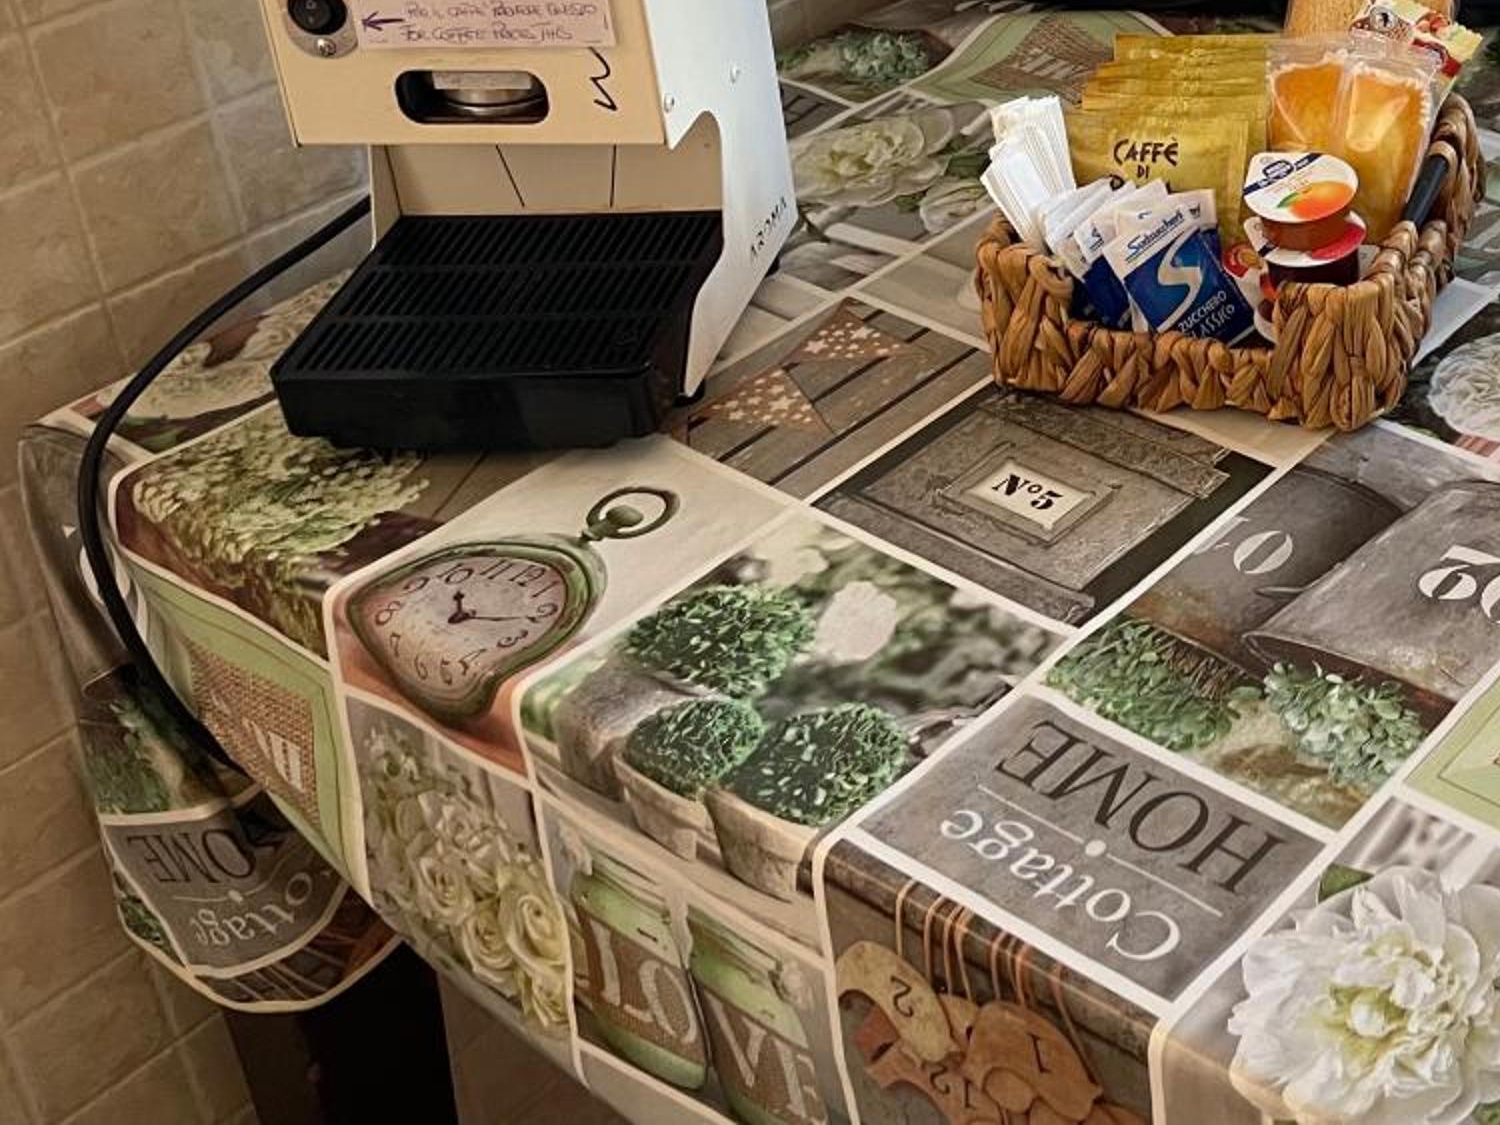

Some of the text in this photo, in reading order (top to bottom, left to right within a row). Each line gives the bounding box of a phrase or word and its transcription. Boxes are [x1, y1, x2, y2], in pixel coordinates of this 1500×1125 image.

[1112, 135, 1179, 167] CAFFÈ
[1136, 164, 1150, 180] DI
[1177, 290, 1228, 334] ZUCCHERO
[375, 600, 403, 626] 8
[994, 719, 1288, 894] HOME
[940, 809, 1182, 961] Cottage
